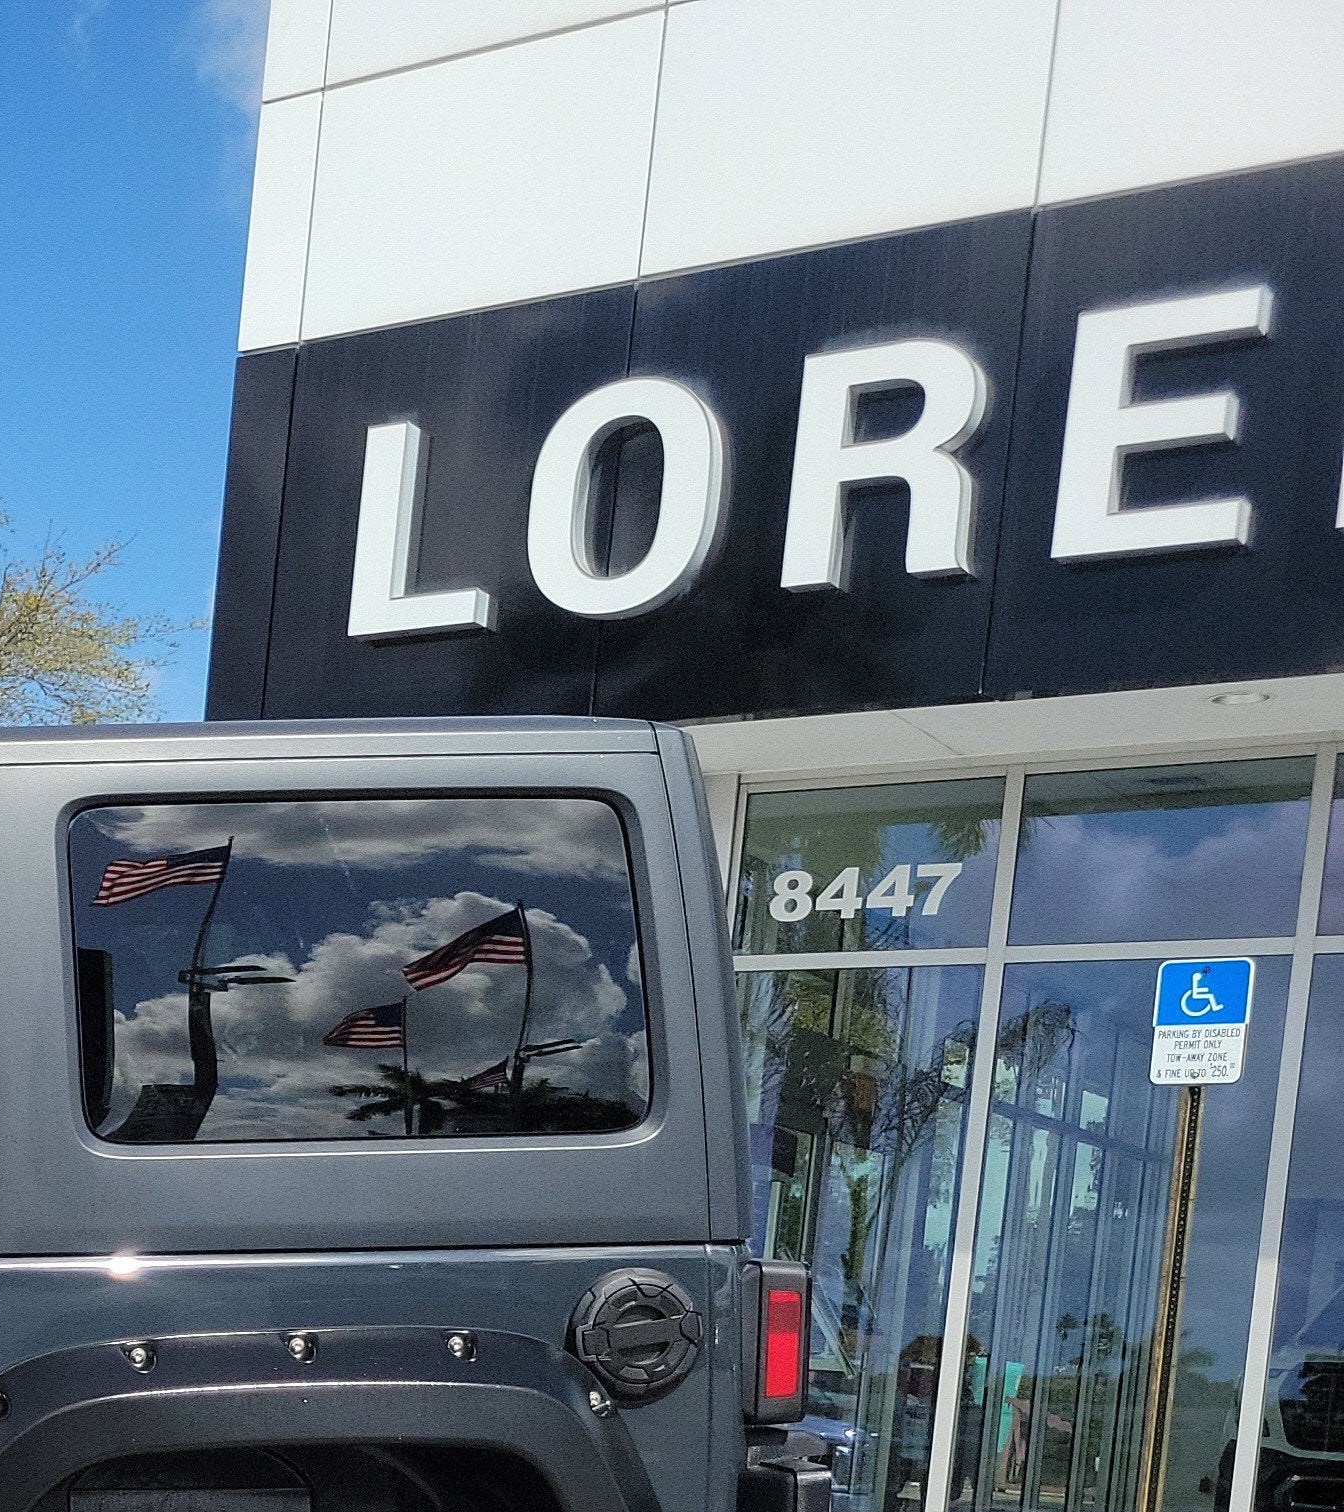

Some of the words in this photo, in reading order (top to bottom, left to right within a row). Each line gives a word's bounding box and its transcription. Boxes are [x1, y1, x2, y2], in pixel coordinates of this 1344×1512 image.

[347, 284, 1344, 638] LORE
[769, 862, 963, 923] 8447
[1158, 1029, 1189, 1039] PARKING
[1192, 1029, 1202, 1039] BY
[1204, 1028, 1241, 1038] DISABLED
[1174, 1040, 1200, 1050] PERMIT
[1203, 1040, 1223, 1049] ONLY
[1167, 1053, 1205, 1063] TOW-AWAY
[1207, 1052, 1228, 1062] ZONE
[1165, 1069, 1180, 1078] FINE
[1197, 1068, 1206, 1077] TO
